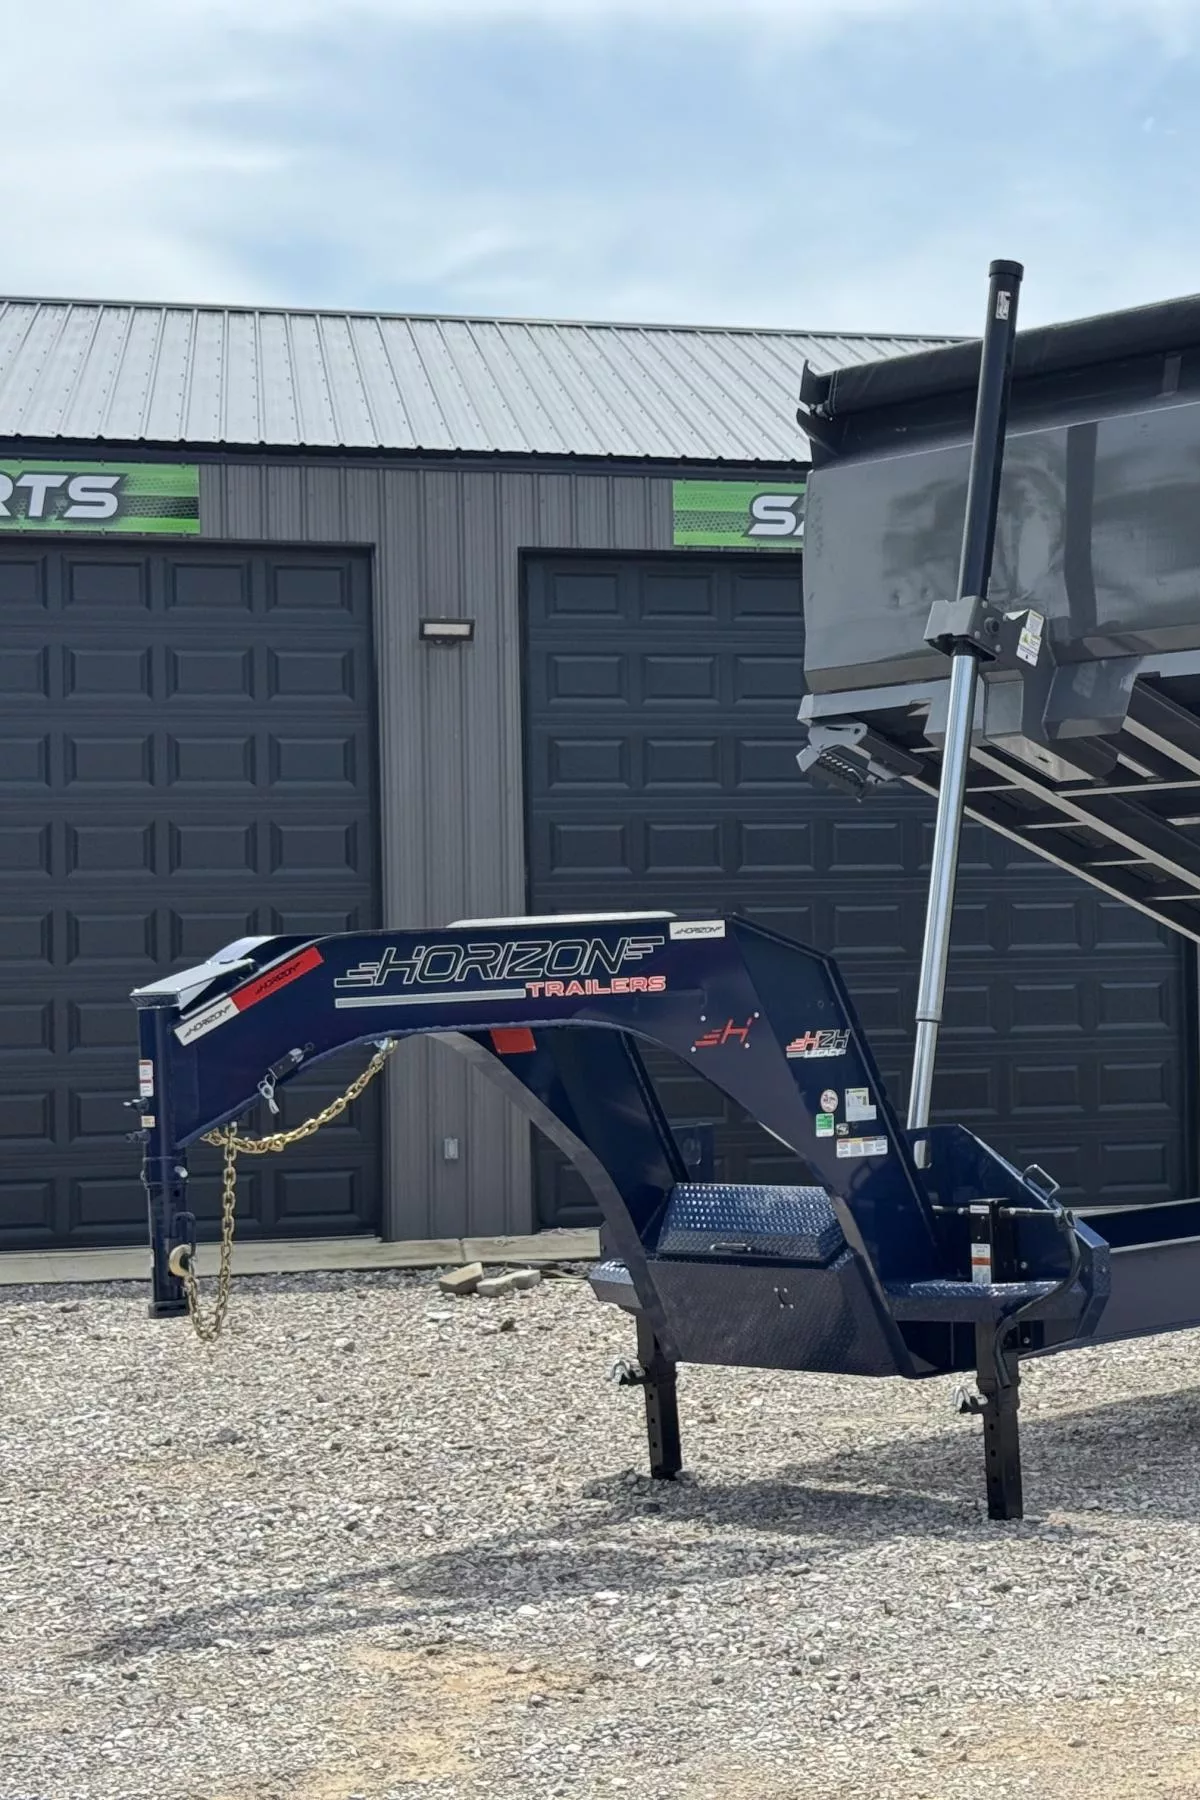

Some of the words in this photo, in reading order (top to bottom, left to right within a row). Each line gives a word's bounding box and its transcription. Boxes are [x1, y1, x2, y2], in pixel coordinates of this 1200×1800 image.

[748, 495, 804, 536] S
[674, 926, 723, 935] HORIZON
[255, 961, 303, 994] HORIZON
[374, 937, 632, 986] HORIZON
[526, 976, 667, 998] TRAILERS
[184, 1004, 232, 1038] HORIZON
